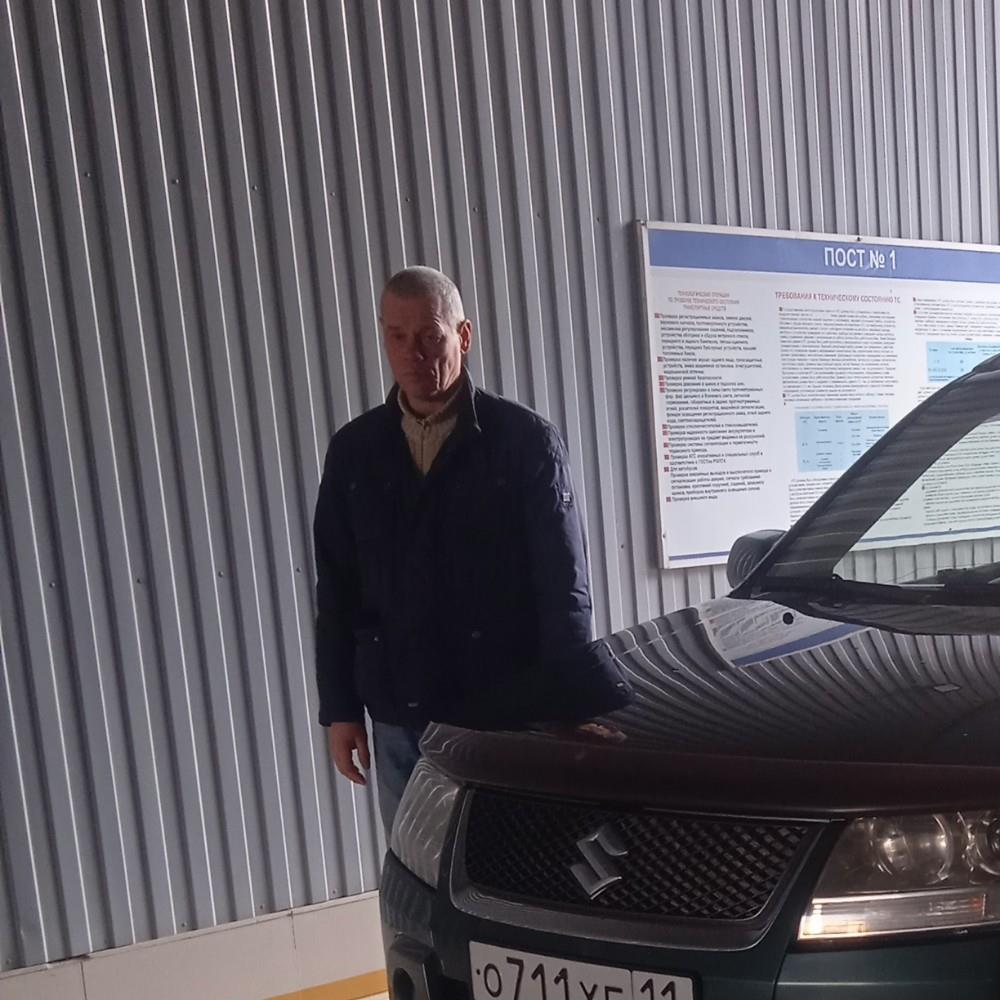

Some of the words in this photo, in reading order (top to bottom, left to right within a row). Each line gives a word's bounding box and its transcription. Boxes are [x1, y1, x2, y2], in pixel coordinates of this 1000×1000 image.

[824, 247, 866, 268] ПОСТ
[869, 250, 886, 269] №
[889, 249, 896, 270] 1
